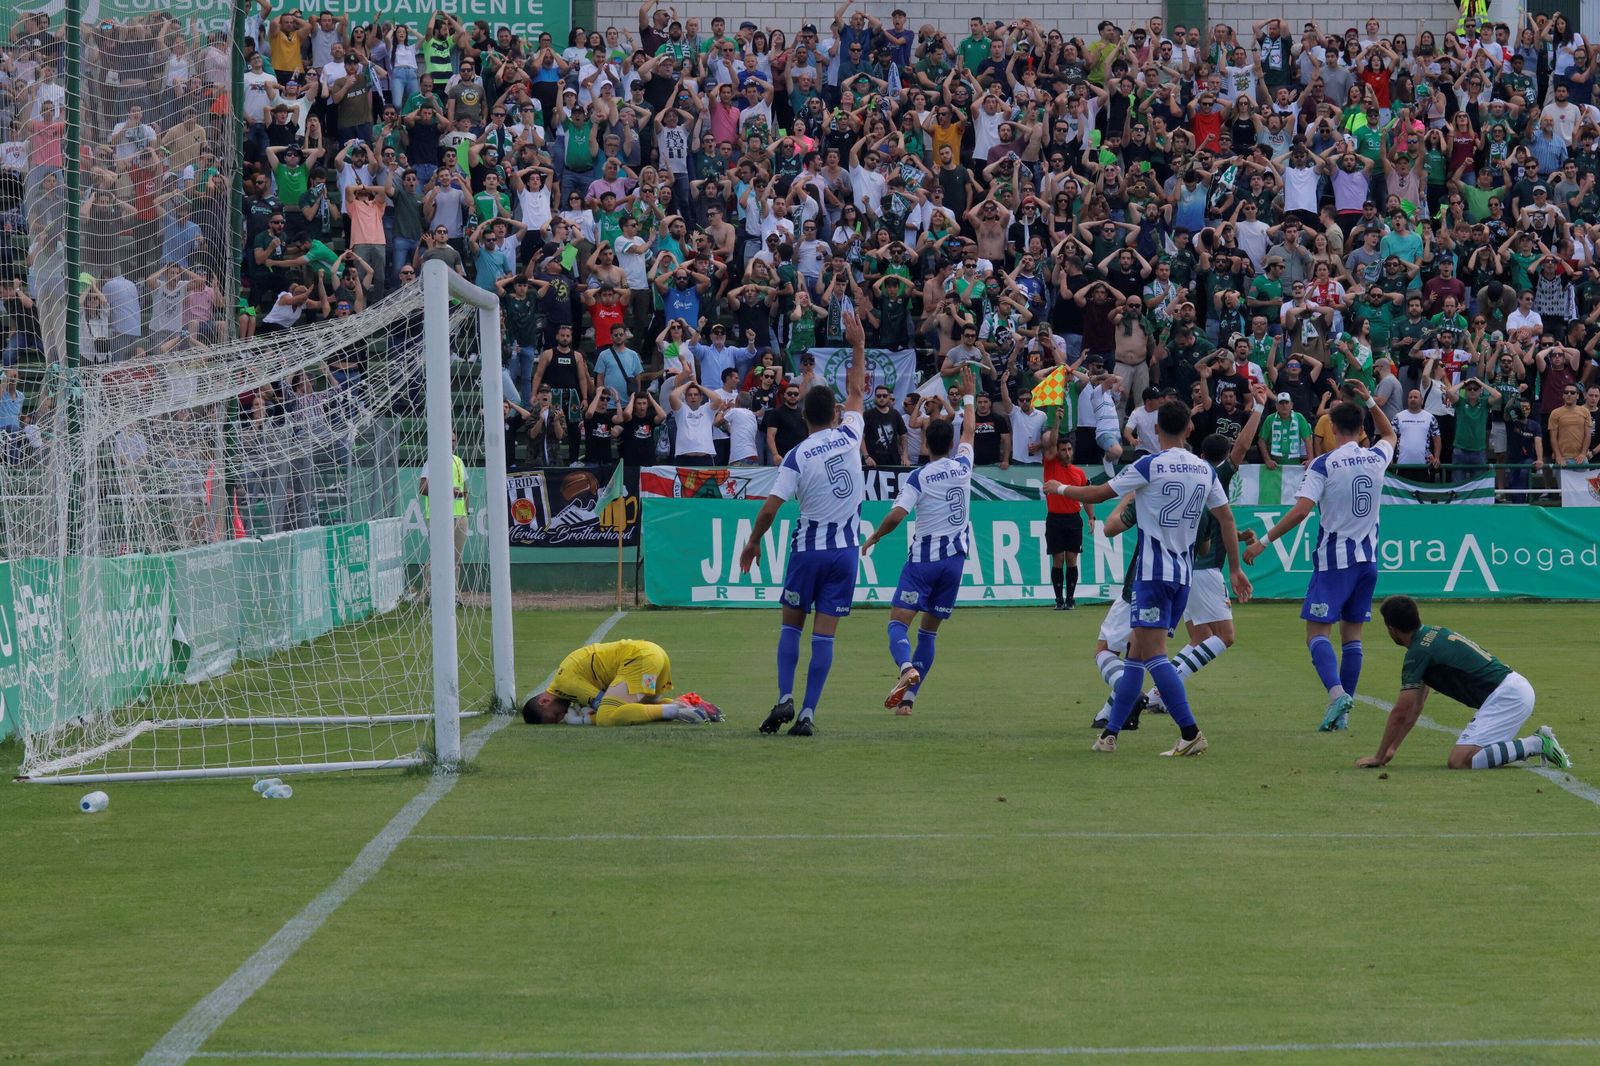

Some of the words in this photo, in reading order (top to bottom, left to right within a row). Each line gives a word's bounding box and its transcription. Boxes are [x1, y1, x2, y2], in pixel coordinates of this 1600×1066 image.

[299, 0, 543, 15] MEDIOAMBIENTE
[824, 454, 854, 499] 5
[925, 470, 949, 484] FRAN
[1156, 463, 1167, 473] R.
[1169, 463, 1208, 475] SERRANO
[1331, 460, 1342, 469] A.
[946, 486, 965, 527] 3
[1159, 480, 1206, 529] 24
[1351, 474, 1373, 518] 6
[701, 517, 878, 585] JAVR
[907, 519, 1124, 585] ARTN
[1254, 512, 1447, 572] Vigra
